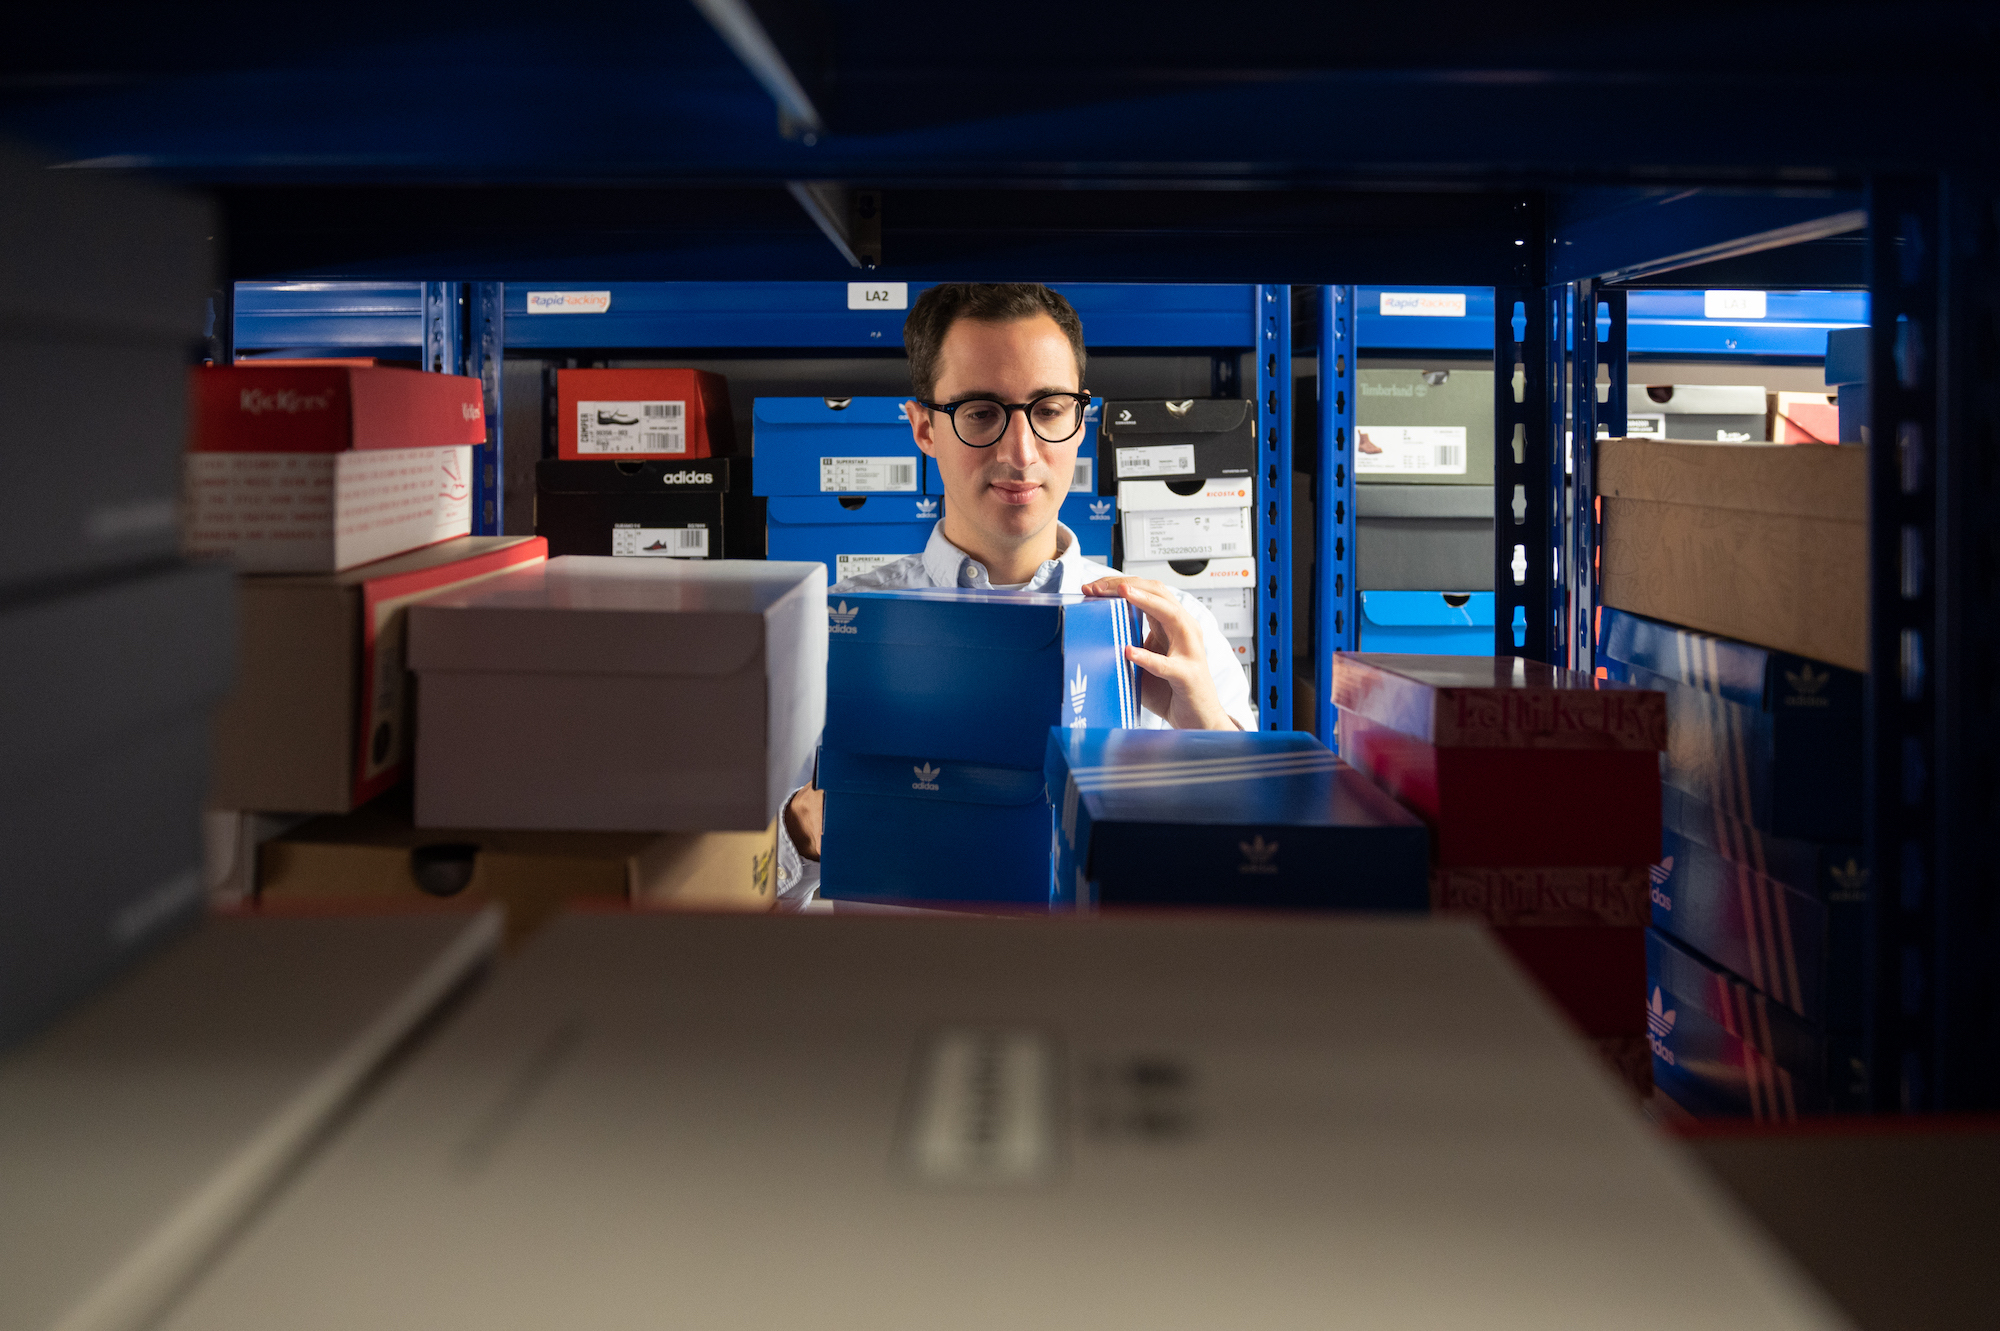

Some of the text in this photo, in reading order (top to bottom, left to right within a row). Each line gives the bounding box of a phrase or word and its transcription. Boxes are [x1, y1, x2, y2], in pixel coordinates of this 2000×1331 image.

[865, 290, 889, 302] LA2
[1360, 382, 1413, 397] Timberland
[580, 413, 589, 443] CAMPER
[663, 470, 714, 485] adidas
[912, 780, 939, 791] adidas
